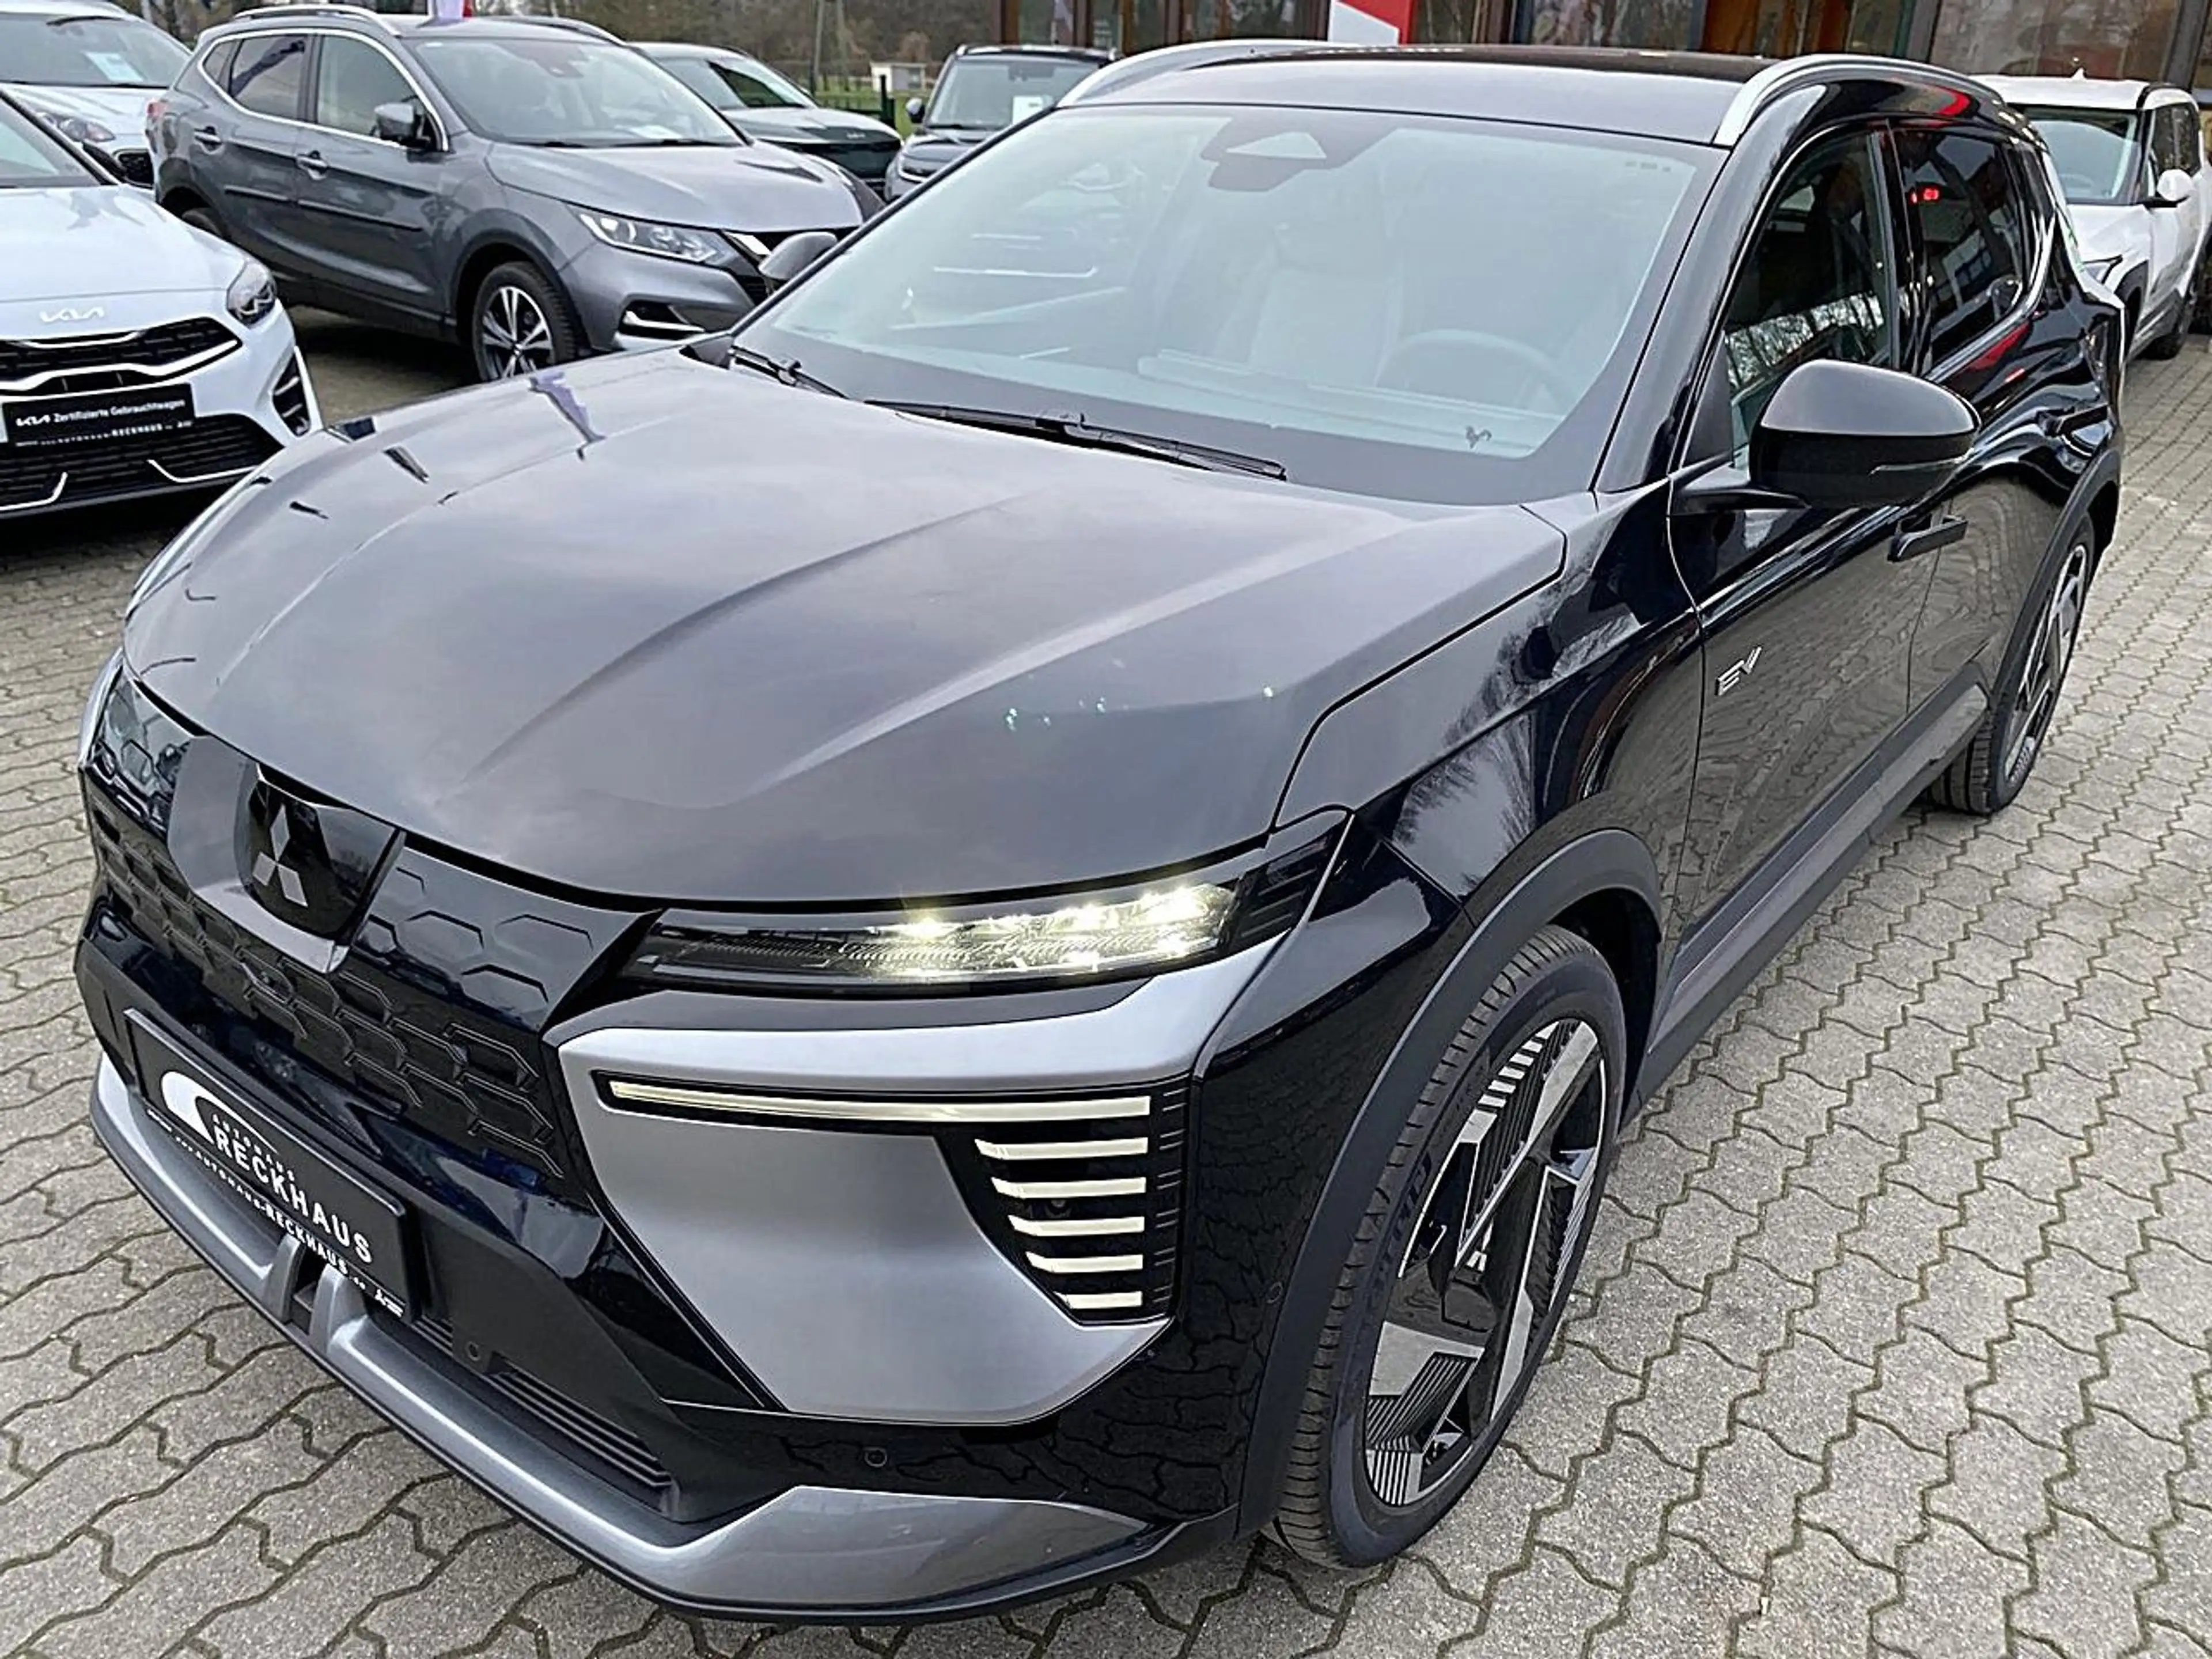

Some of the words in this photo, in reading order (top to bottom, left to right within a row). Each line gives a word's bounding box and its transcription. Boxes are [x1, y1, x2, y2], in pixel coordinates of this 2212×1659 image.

[39, 306, 104, 322] KIA
[16, 414, 51, 426] KIA
[1717, 646, 1762, 696] EV
[213, 1124, 372, 1263] RECKHAUS
